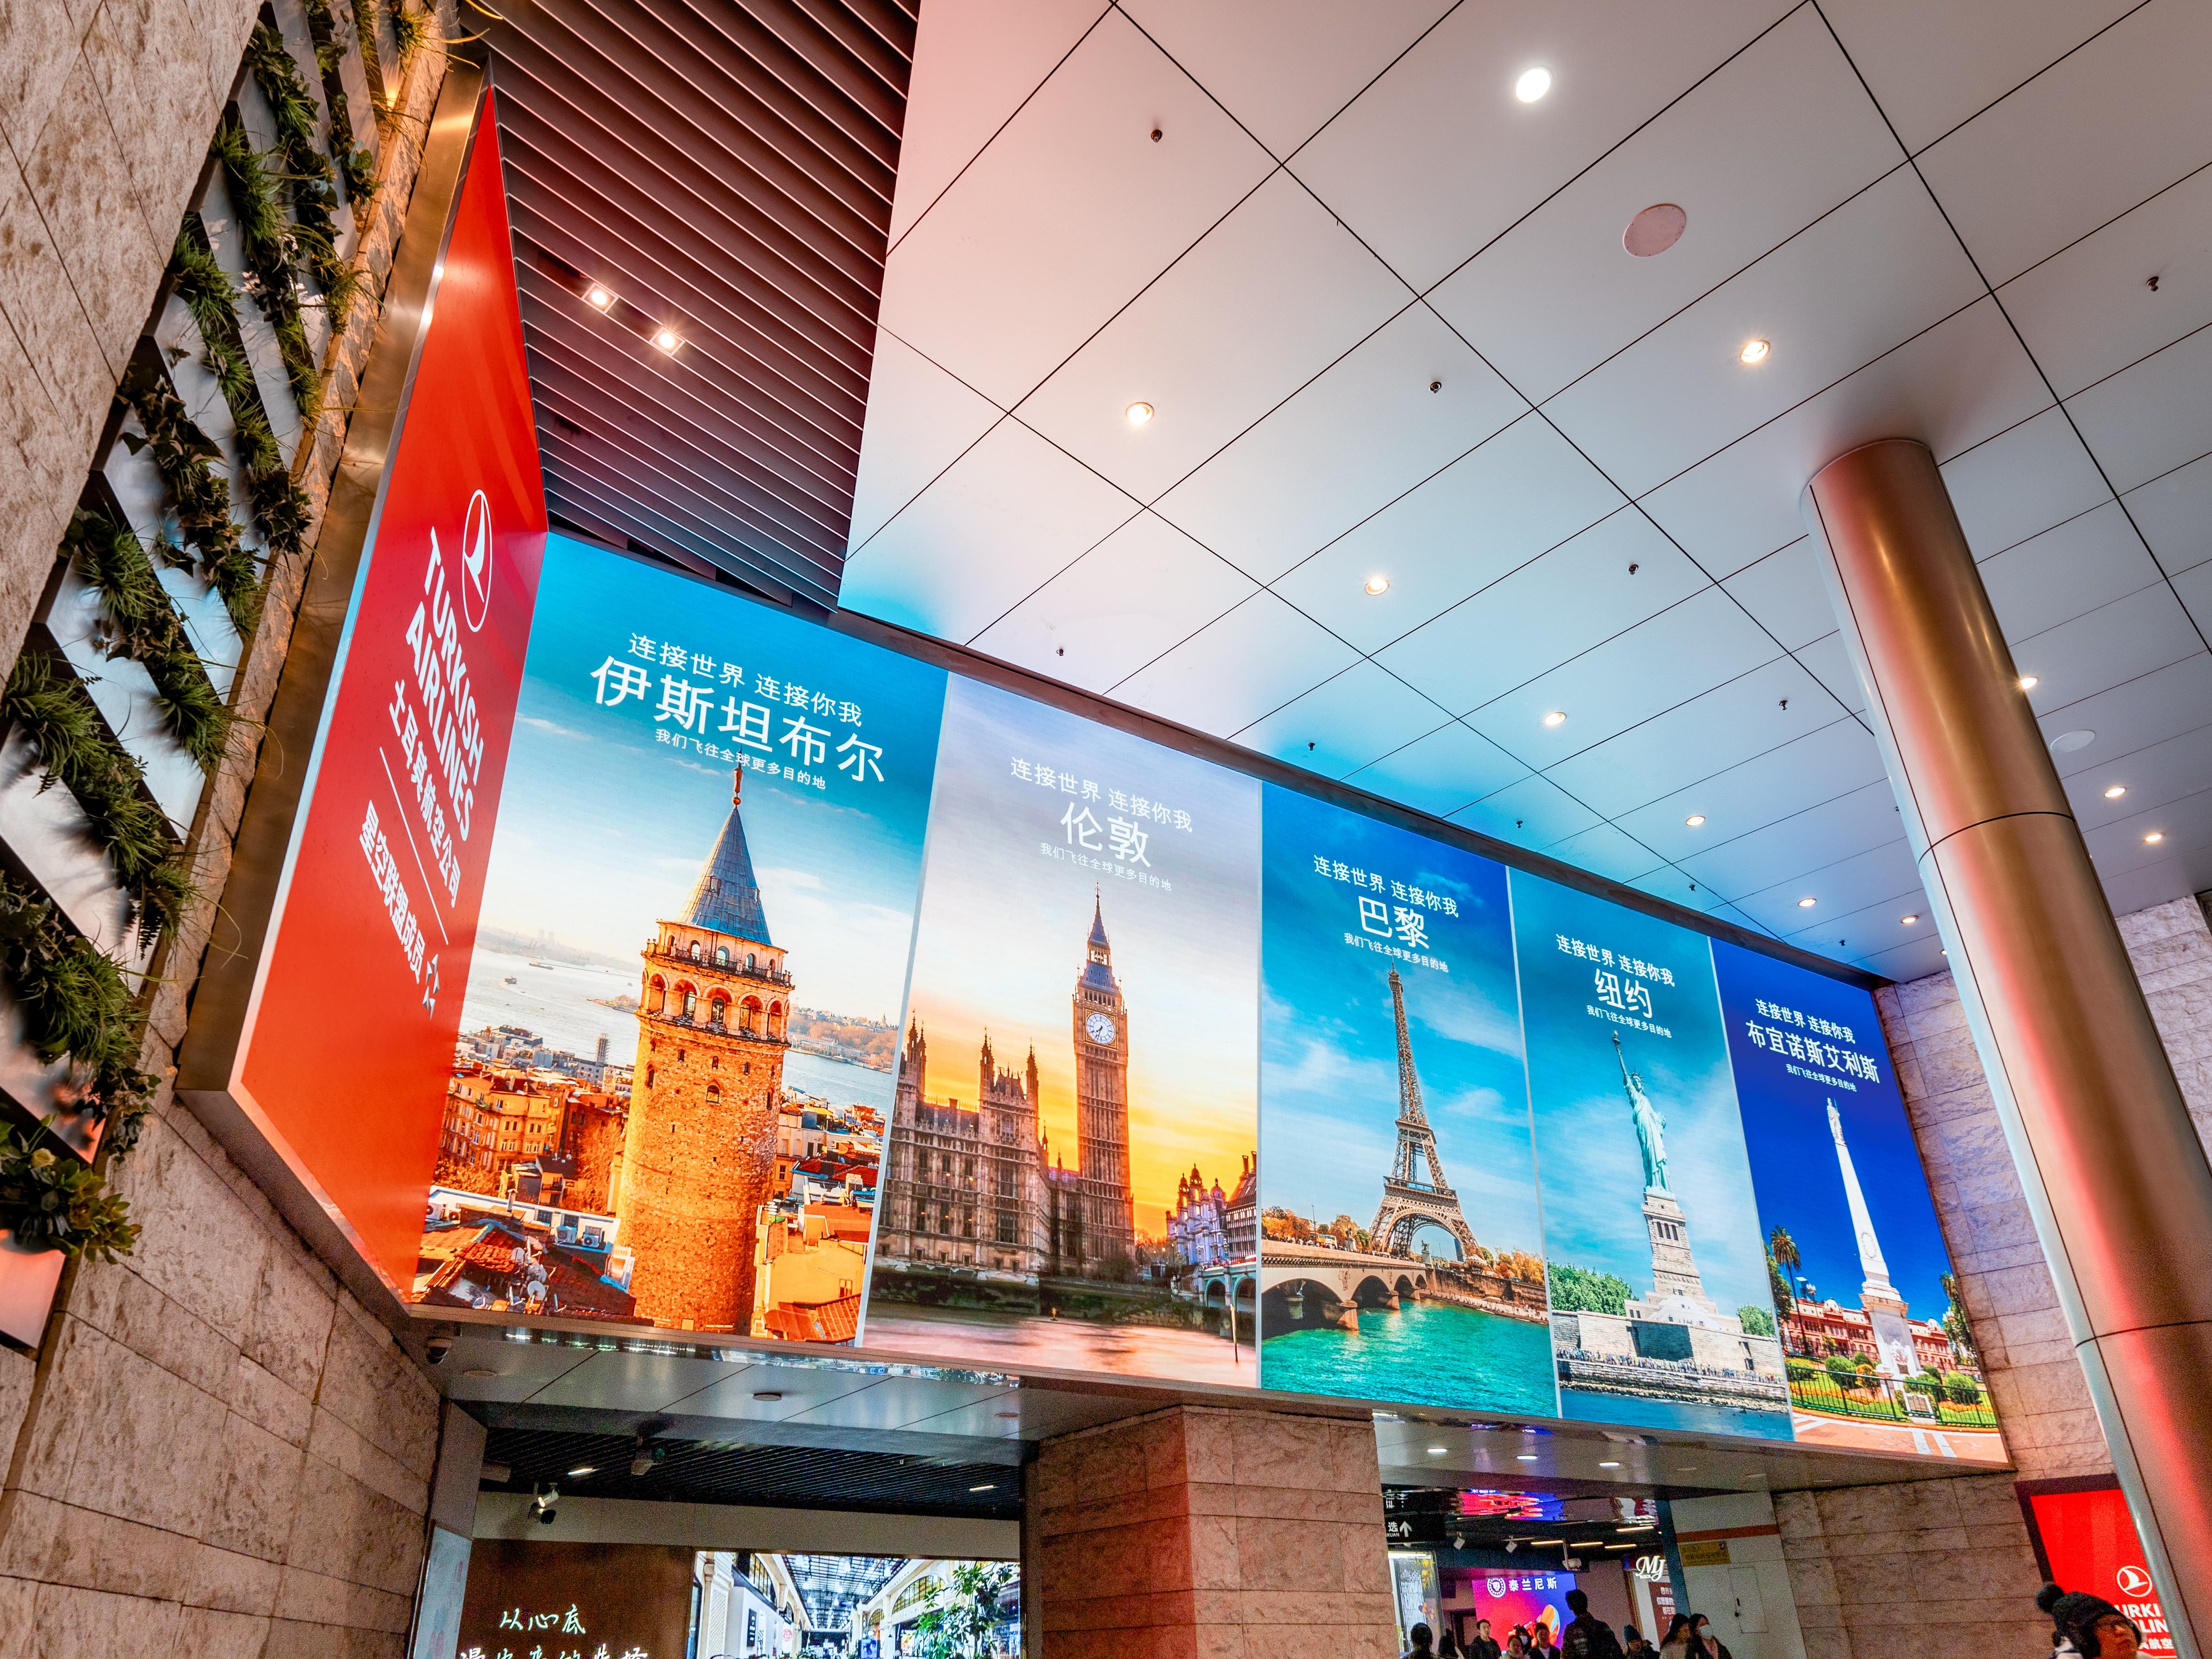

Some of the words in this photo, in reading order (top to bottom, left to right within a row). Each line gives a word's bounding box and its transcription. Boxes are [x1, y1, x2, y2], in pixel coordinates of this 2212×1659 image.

[423, 526, 484, 786] TURKISH
[627, 633, 746, 688] 连接世界
[754, 673, 862, 727] 连接你我
[405, 600, 475, 842] AIRLINES
[590, 655, 884, 783] 伊斯坦布尔
[656, 729, 826, 790] 我们飞往全球更多目的地
[389, 679, 461, 908] 土耳其航空公司
[1011, 756, 1101, 802] 连接世界
[1109, 789, 1193, 832] 连接你我
[1060, 802, 1151, 868] 伦敦
[359, 799, 425, 985] 星空联盟成员
[1040, 842, 1171, 892] 我们飞往全球更多目的地
[1313, 854, 1385, 893] 连接世界
[1391, 880, 1458, 917] 连接你我
[1358, 896, 1430, 949] 巴黎
[1344, 932, 1448, 972] 我们飞往全球更多目的地
[1556, 934, 1615, 967] 连接世界
[1618, 954, 1675, 987] 连接你我
[1586, 1005, 1671, 1038] 我们飞往全球更多目的地
[1594, 969, 1653, 1018] 纽约
[1756, 999, 1805, 1028] 连接世界
[1807, 1016, 1856, 1044] 连接你我
[1746, 1020, 1880, 1083] 布宜诺斯艾利斯
[1786, 1064, 1857, 1092] 我们飞往全球更多目的地
[1508, 1577, 1557, 1592] 泰兰尼斯
[499, 1604, 586, 1634] 以心底
[2138, 1619, 2169, 1633] LIN
